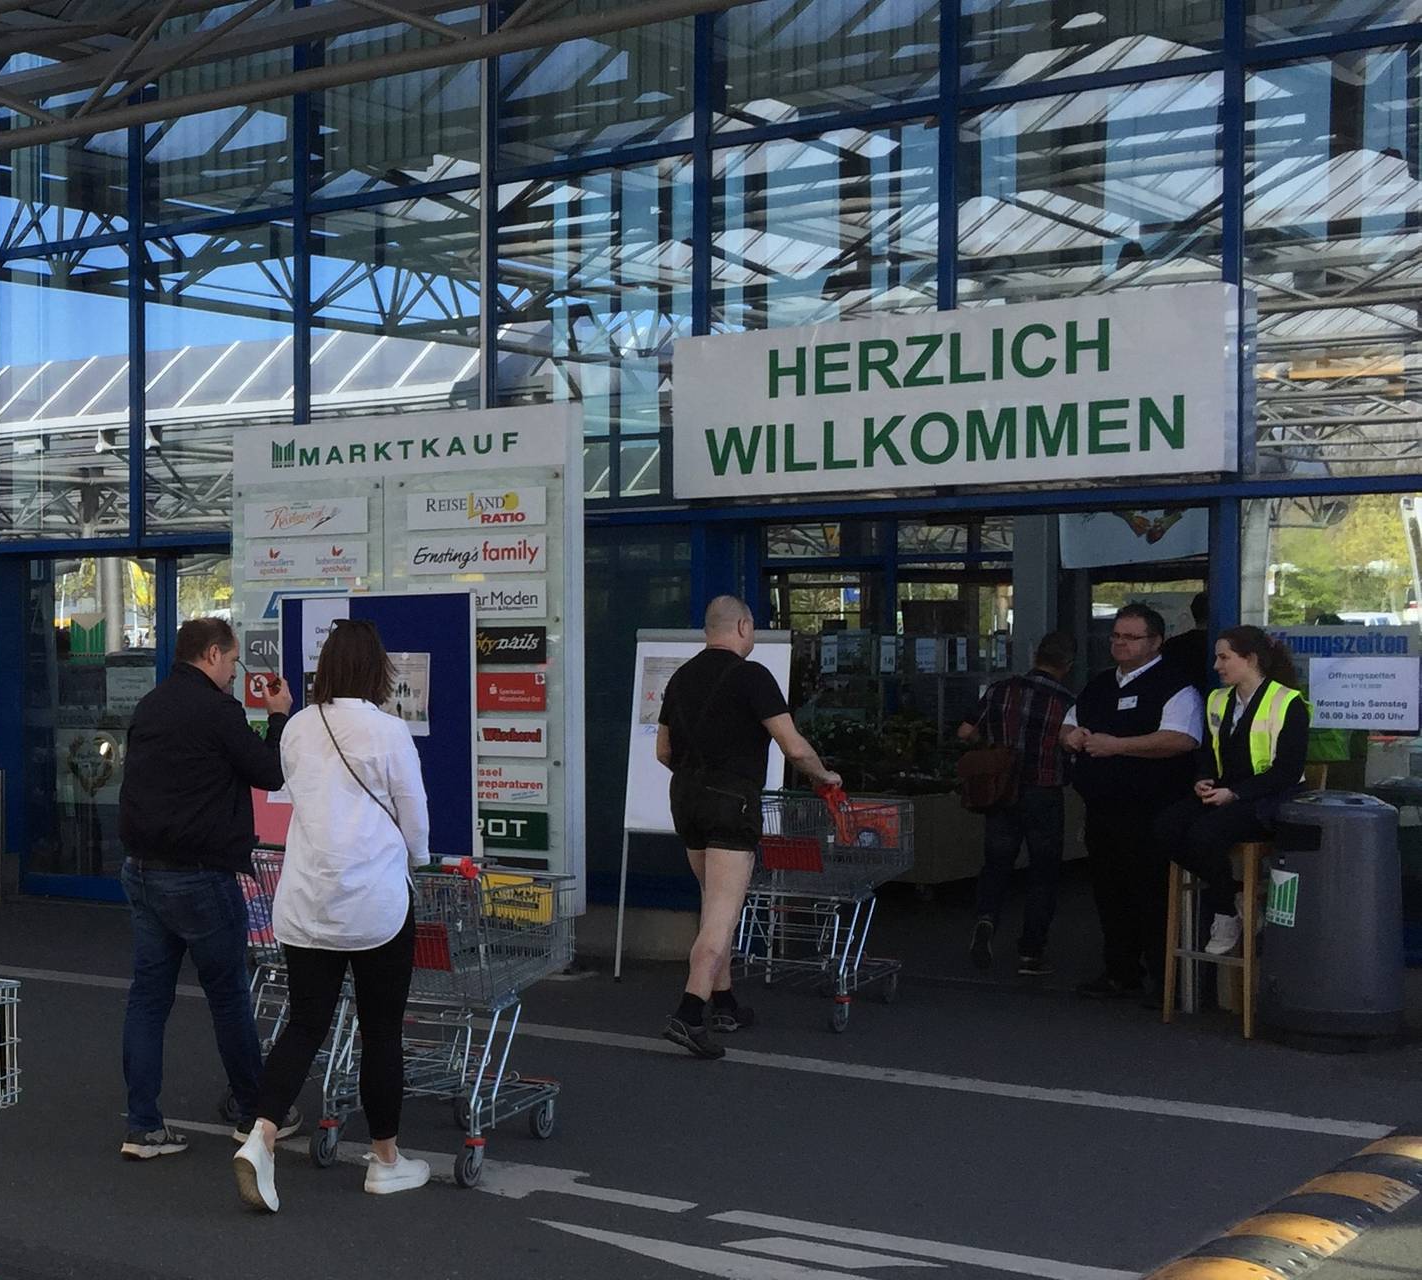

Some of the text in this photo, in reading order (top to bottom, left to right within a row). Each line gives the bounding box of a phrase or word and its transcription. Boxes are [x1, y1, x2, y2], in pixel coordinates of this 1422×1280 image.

[768, 318, 1110, 398] HERZLICH
[705, 395, 1185, 476] WILLKOMMEN
[299, 432, 519, 466] MARKTKAUF
[481, 512, 526, 524] RATIO
[413, 539, 539, 569] Ernsting's family
[476, 590, 539, 606] ar Moden
[1270, 632, 1408, 657] ffnungszeiten
[1317, 700, 1350, 709] Montag
[1368, 700, 1407, 709] Samstag
[1346, 712, 1359, 720] bis
[1362, 712, 1385, 720] 20.00
[477, 780, 543, 790] reparaturen
